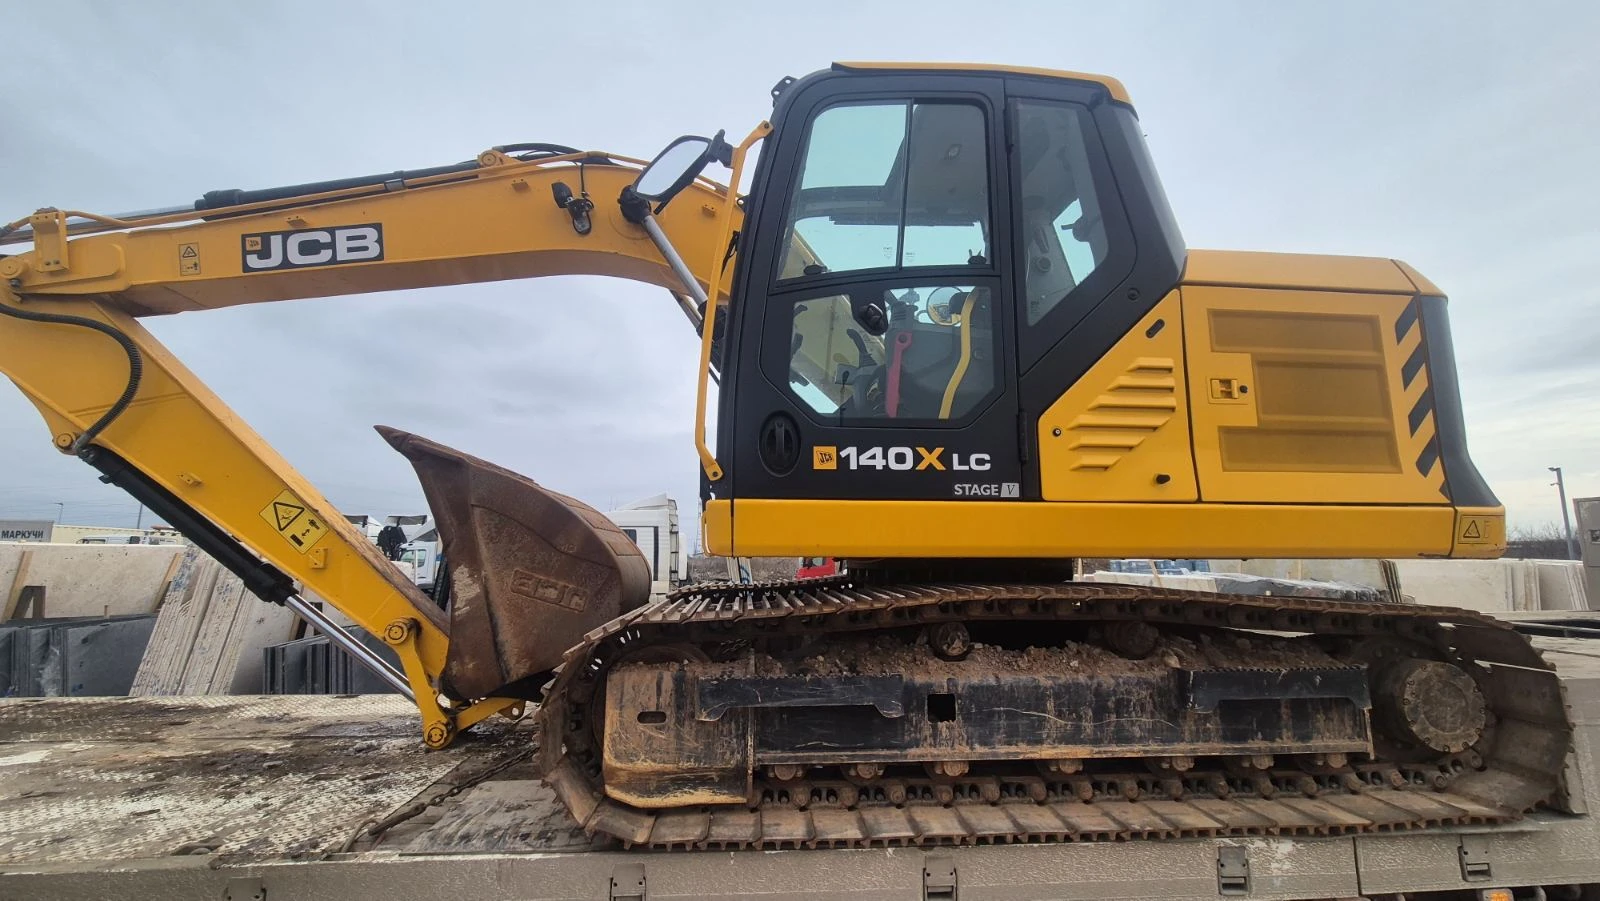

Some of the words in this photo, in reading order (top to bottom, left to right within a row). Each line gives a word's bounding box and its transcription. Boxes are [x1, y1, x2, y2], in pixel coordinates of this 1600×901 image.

[246, 227, 381, 269] JCB
[840, 446, 947, 471] 140X
[952, 453, 991, 471] LC
[954, 483, 999, 496] STAGE
[1, 530, 44, 539] МАРКУЧИ
